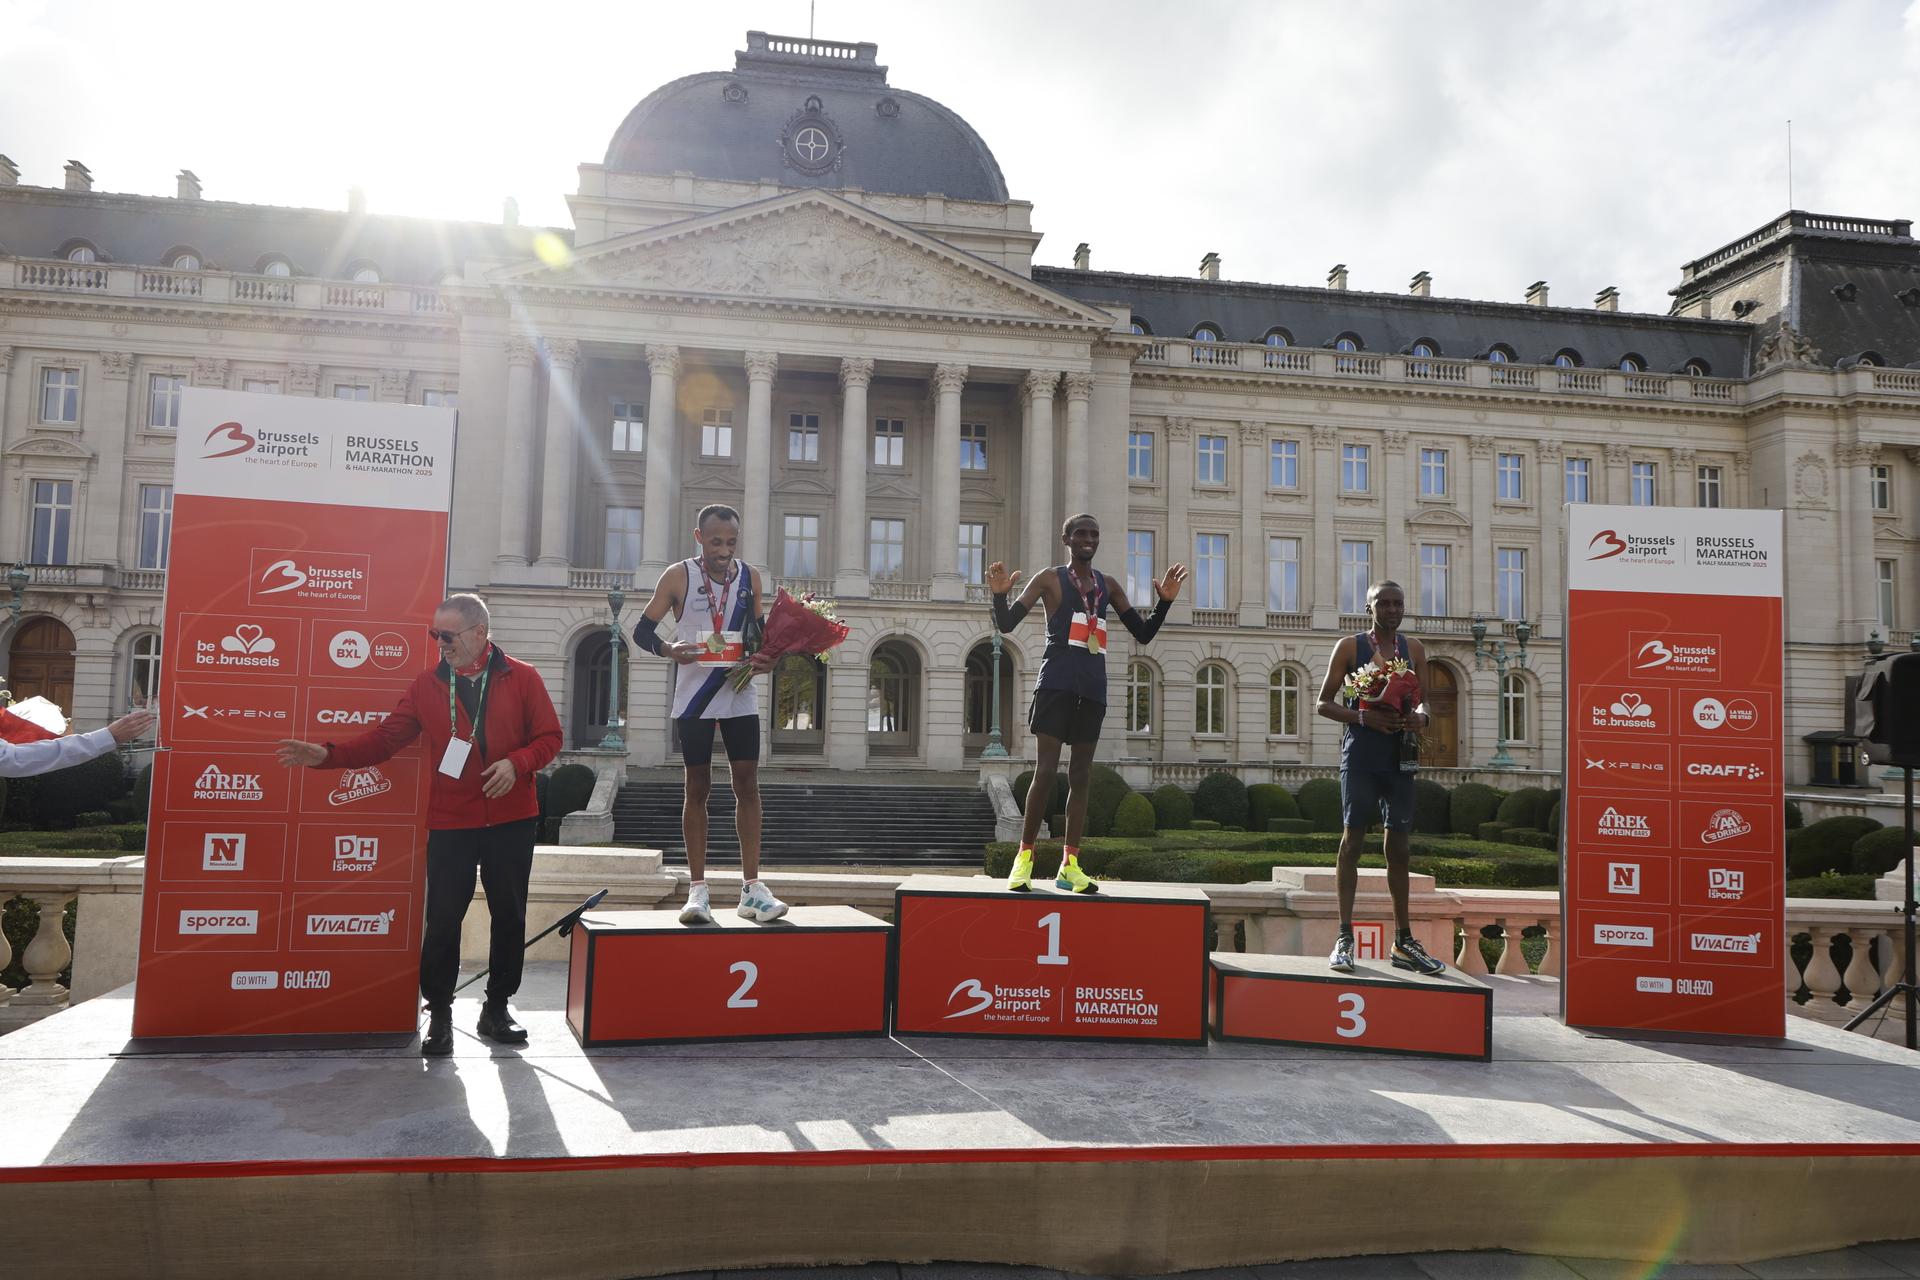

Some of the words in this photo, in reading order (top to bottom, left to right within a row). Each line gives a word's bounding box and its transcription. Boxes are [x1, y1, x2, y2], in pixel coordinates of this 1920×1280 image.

[257, 429, 319, 444] brussels
[257, 442, 308, 457] airport
[347, 436, 418, 452] BRUSSELS
[260, 457, 280, 465] heart
[291, 460, 318, 469] Europe
[346, 450, 434, 467] MARATHON
[372, 467, 413, 475] MARATHON
[1628, 534, 1675, 545] brussels
[1697, 537, 1754, 548] BRUSSELS
[1628, 544, 1667, 556] airport
[1697, 549, 1767, 560] MARATHON
[309, 565, 363, 579] brussels
[308, 577, 353, 590] airport
[338, 592, 361, 600] Europe
[197, 640, 215, 652] be
[1673, 645, 1716, 655] brussels
[337, 649, 361, 659] BXL
[1673, 654, 1709, 665] airport
[214, 708, 286, 719] XPENG
[317, 709, 392, 724] CRAFT
[1593, 706, 1606, 716] be
[1700, 713, 1720, 721] BXL
[1608, 762, 1664, 771] XPENG
[1687, 763, 1747, 777] CRAFT
[202, 773, 263, 790] TREK
[352, 772, 375, 790] AA
[193, 790, 237, 800] PROTEIN
[348, 783, 381, 799] DRINK
[1603, 814, 1649, 829] TREK
[1720, 816, 1738, 830] AA
[1599, 828, 1631, 836] PROTEIN
[1717, 826, 1743, 838] DRINK
[210, 838, 239, 861] N
[1614, 867, 1635, 886] N
[187, 916, 251, 931] sporza.
[1037, 912, 1069, 965] 1
[1600, 930, 1648, 942] sporza.
[236, 976, 247, 985] GO
[248, 976, 267, 985] WITH
[284, 970, 331, 989] GOLAZO
[727, 961, 758, 1008] 2
[995, 985, 1051, 998] brussels
[1076, 987, 1144, 1001] BRUSSELS
[1677, 979, 1713, 996] GOLAZO
[995, 997, 1041, 1012] airport
[1075, 1002, 1158, 1016] MARATHON
[1099, 1017, 1139, 1025] MARATHON
[1336, 993, 1367, 1038] 3
